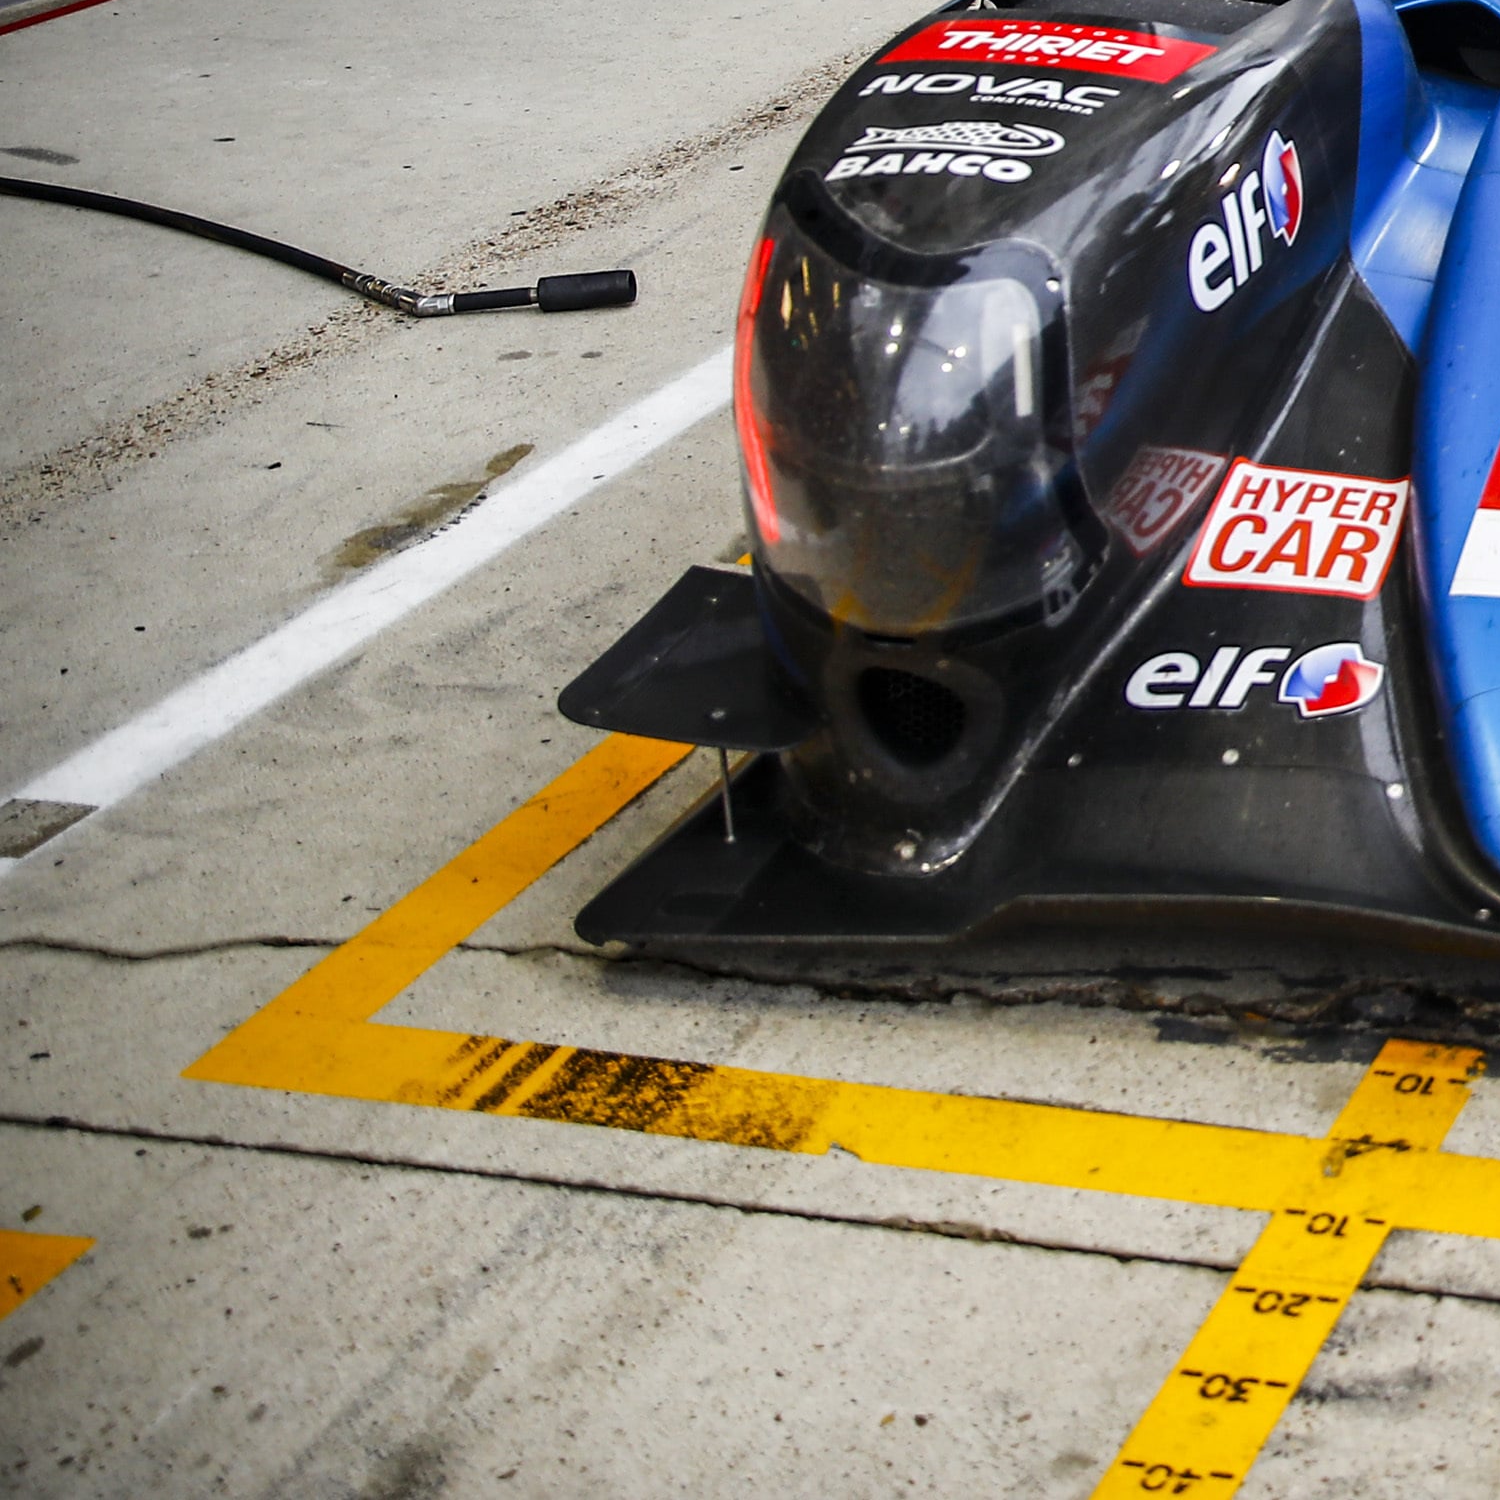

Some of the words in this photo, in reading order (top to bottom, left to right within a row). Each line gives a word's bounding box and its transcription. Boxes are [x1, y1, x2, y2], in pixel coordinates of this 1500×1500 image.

[938, 30, 1166, 66] THIRIET
[1002, 23, 1130, 42] MAISON
[858, 74, 1121, 108] NOVAC
[969, 93, 1094, 116] CONSTRUTORA
[824, 151, 1033, 184] BAHCO
[1188, 187, 1270, 314] elf
[1230, 475, 1398, 527] HYPER
[1209, 513, 1381, 584] CAR
[1125, 645, 1292, 711] elf
[1394, 1072, 1436, 1096] 10
[1306, 1211, 1349, 1238] 10
[1253, 1288, 1313, 1318] 20
[1199, 1372, 1260, 1403] 30
[1140, 1462, 1203, 1495] 40
